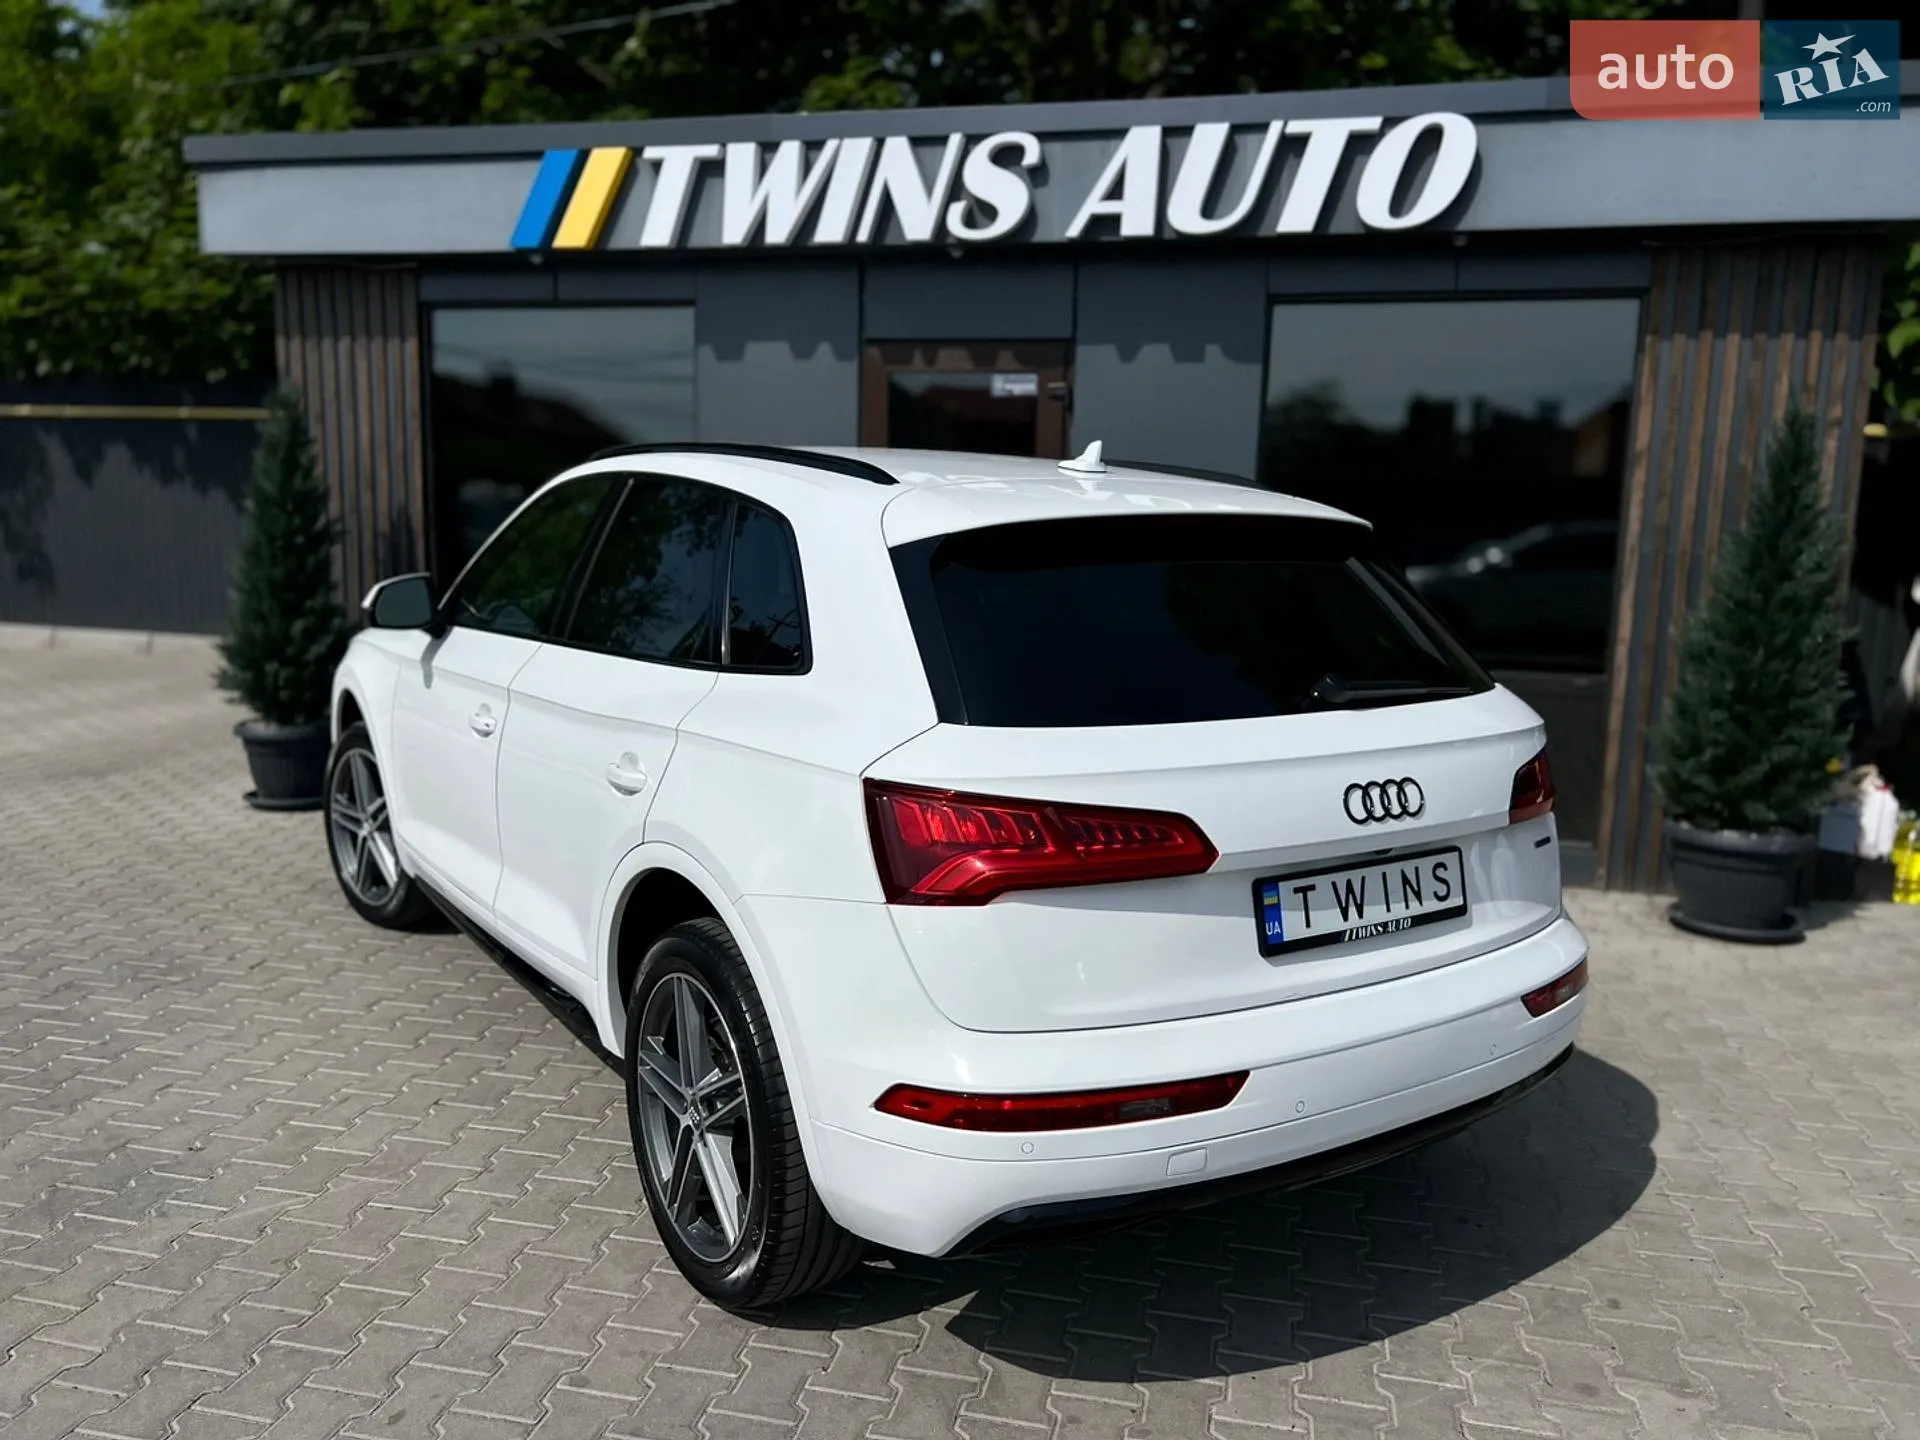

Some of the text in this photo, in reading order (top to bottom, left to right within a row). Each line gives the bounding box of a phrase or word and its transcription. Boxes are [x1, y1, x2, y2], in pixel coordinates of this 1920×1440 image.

[640, 111, 1478, 245] TWINS AUTO
[1265, 921, 1282, 936] UA
[1293, 862, 1451, 929] TWINS
